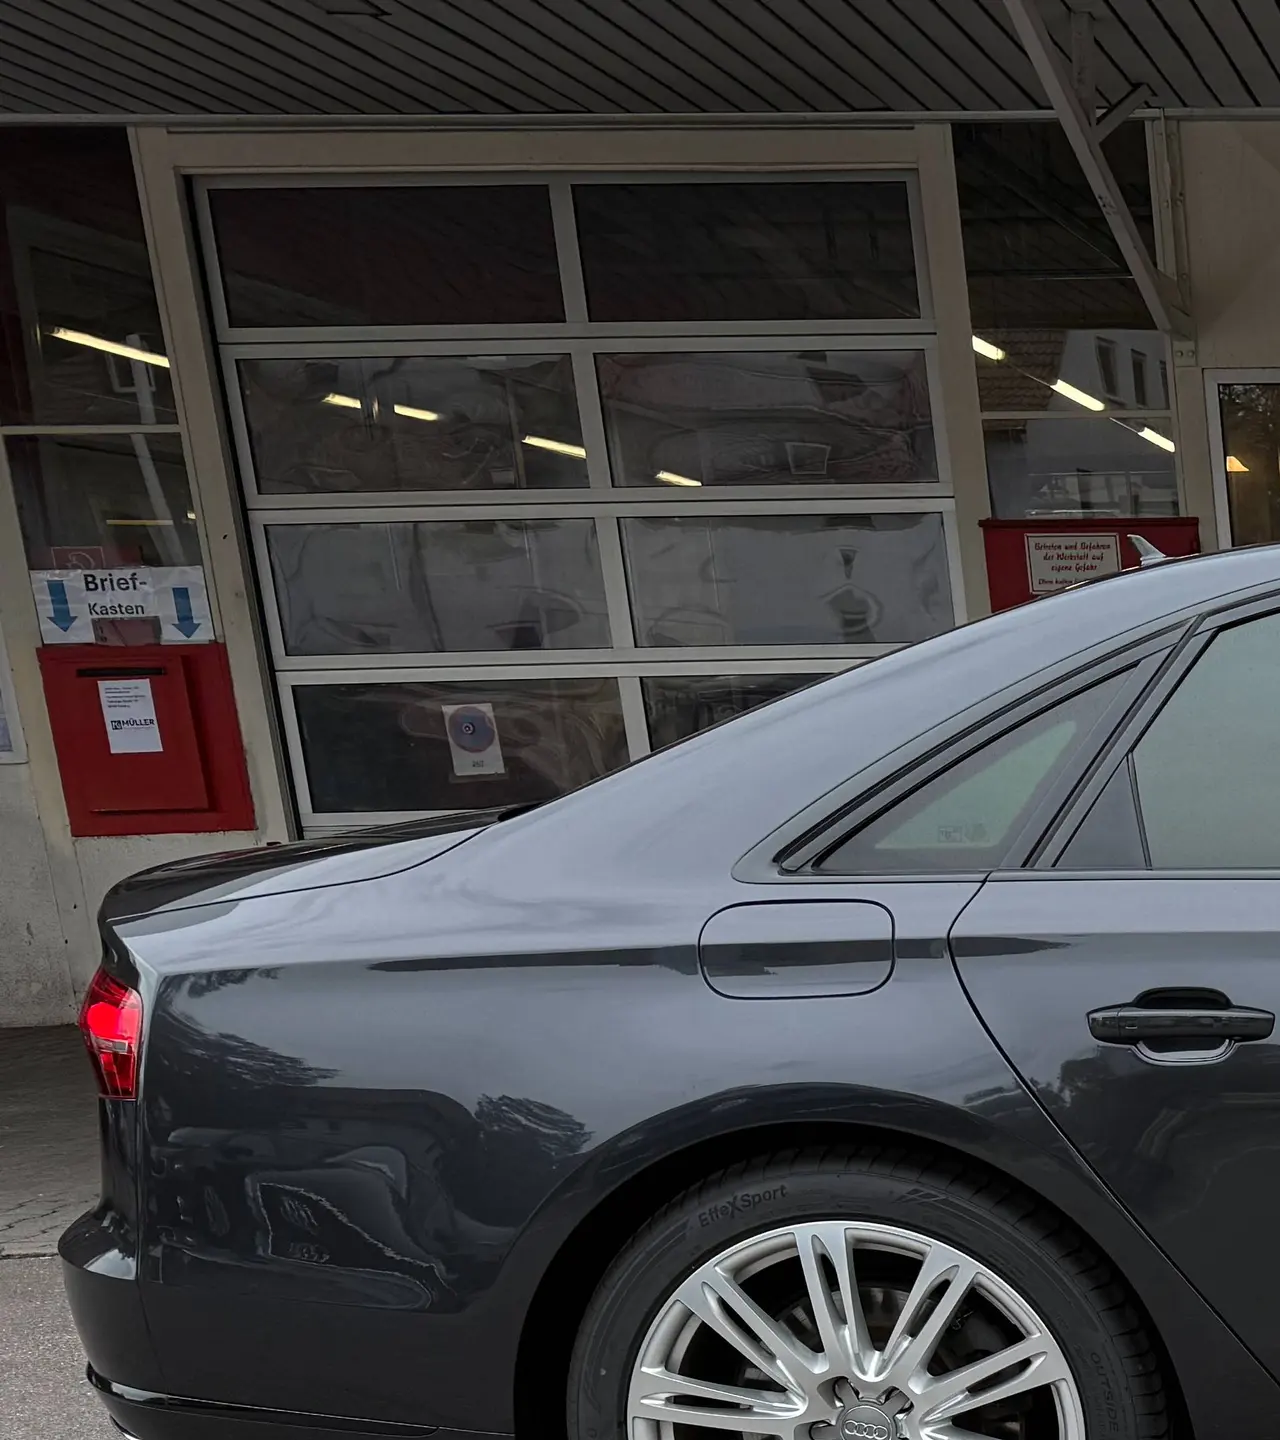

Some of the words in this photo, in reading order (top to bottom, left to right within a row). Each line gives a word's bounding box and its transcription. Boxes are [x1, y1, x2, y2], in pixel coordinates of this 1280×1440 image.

[83, 572, 148, 592] Brief-
[87, 602, 145, 616] Kasten
[122, 718, 156, 727] MÜLLER
[1090, 1351, 1119, 1433] OUTSIDE
